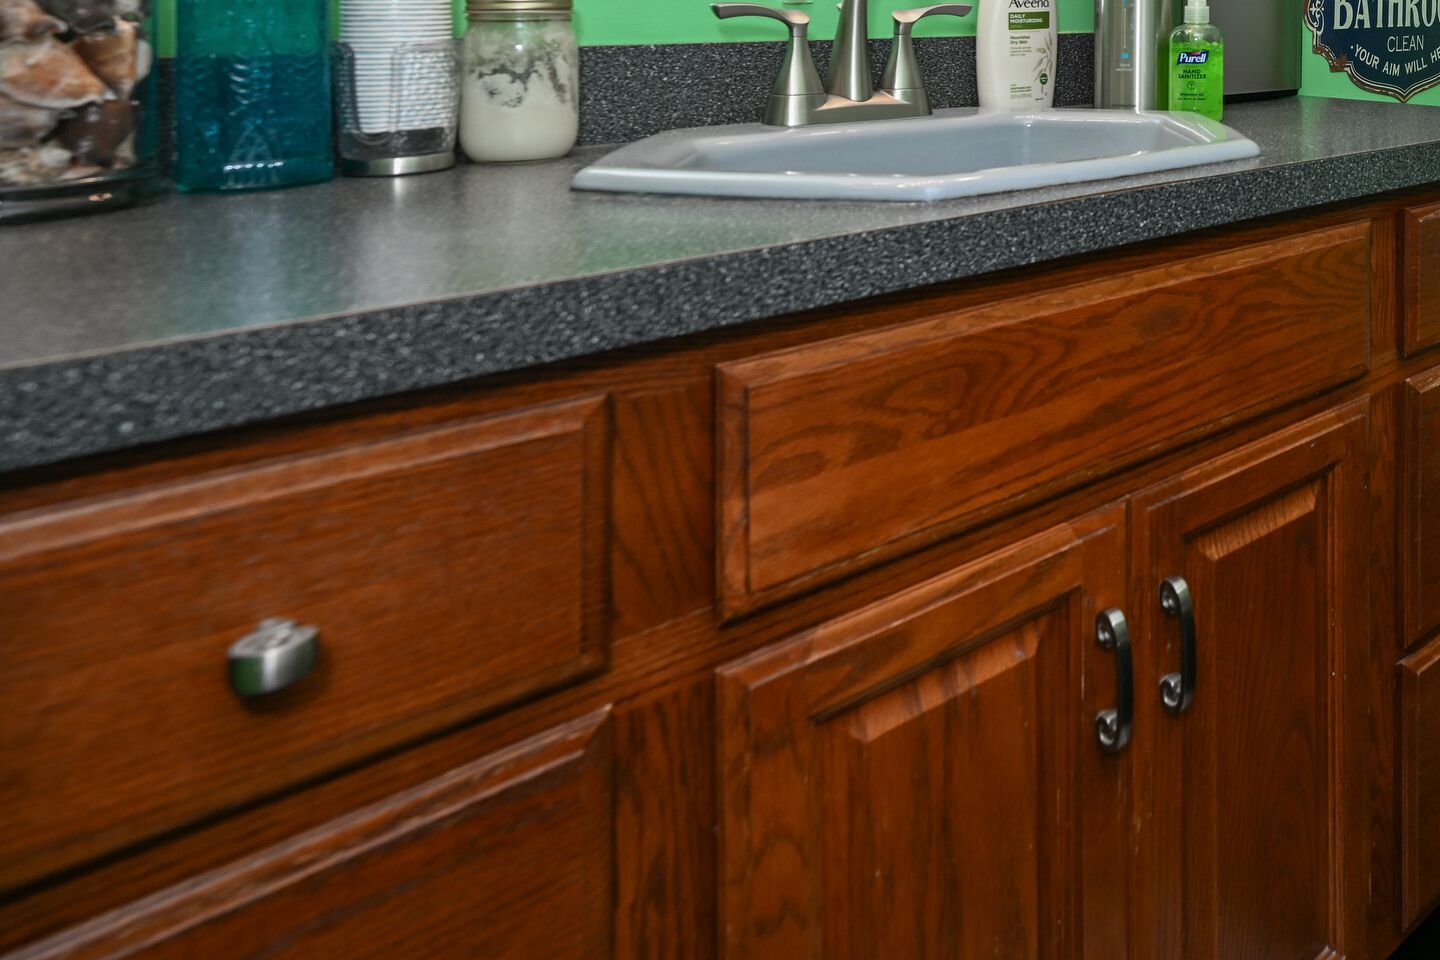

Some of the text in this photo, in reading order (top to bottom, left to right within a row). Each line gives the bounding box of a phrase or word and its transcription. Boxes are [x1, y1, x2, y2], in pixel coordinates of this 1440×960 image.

[1387, 35, 1425, 53] CLEAN
[1179, 52, 1207, 63] Purell
[1354, 43, 1380, 70] YOUR
[1382, 60, 1400, 77] AIM
[1404, 58, 1428, 76] WILL
